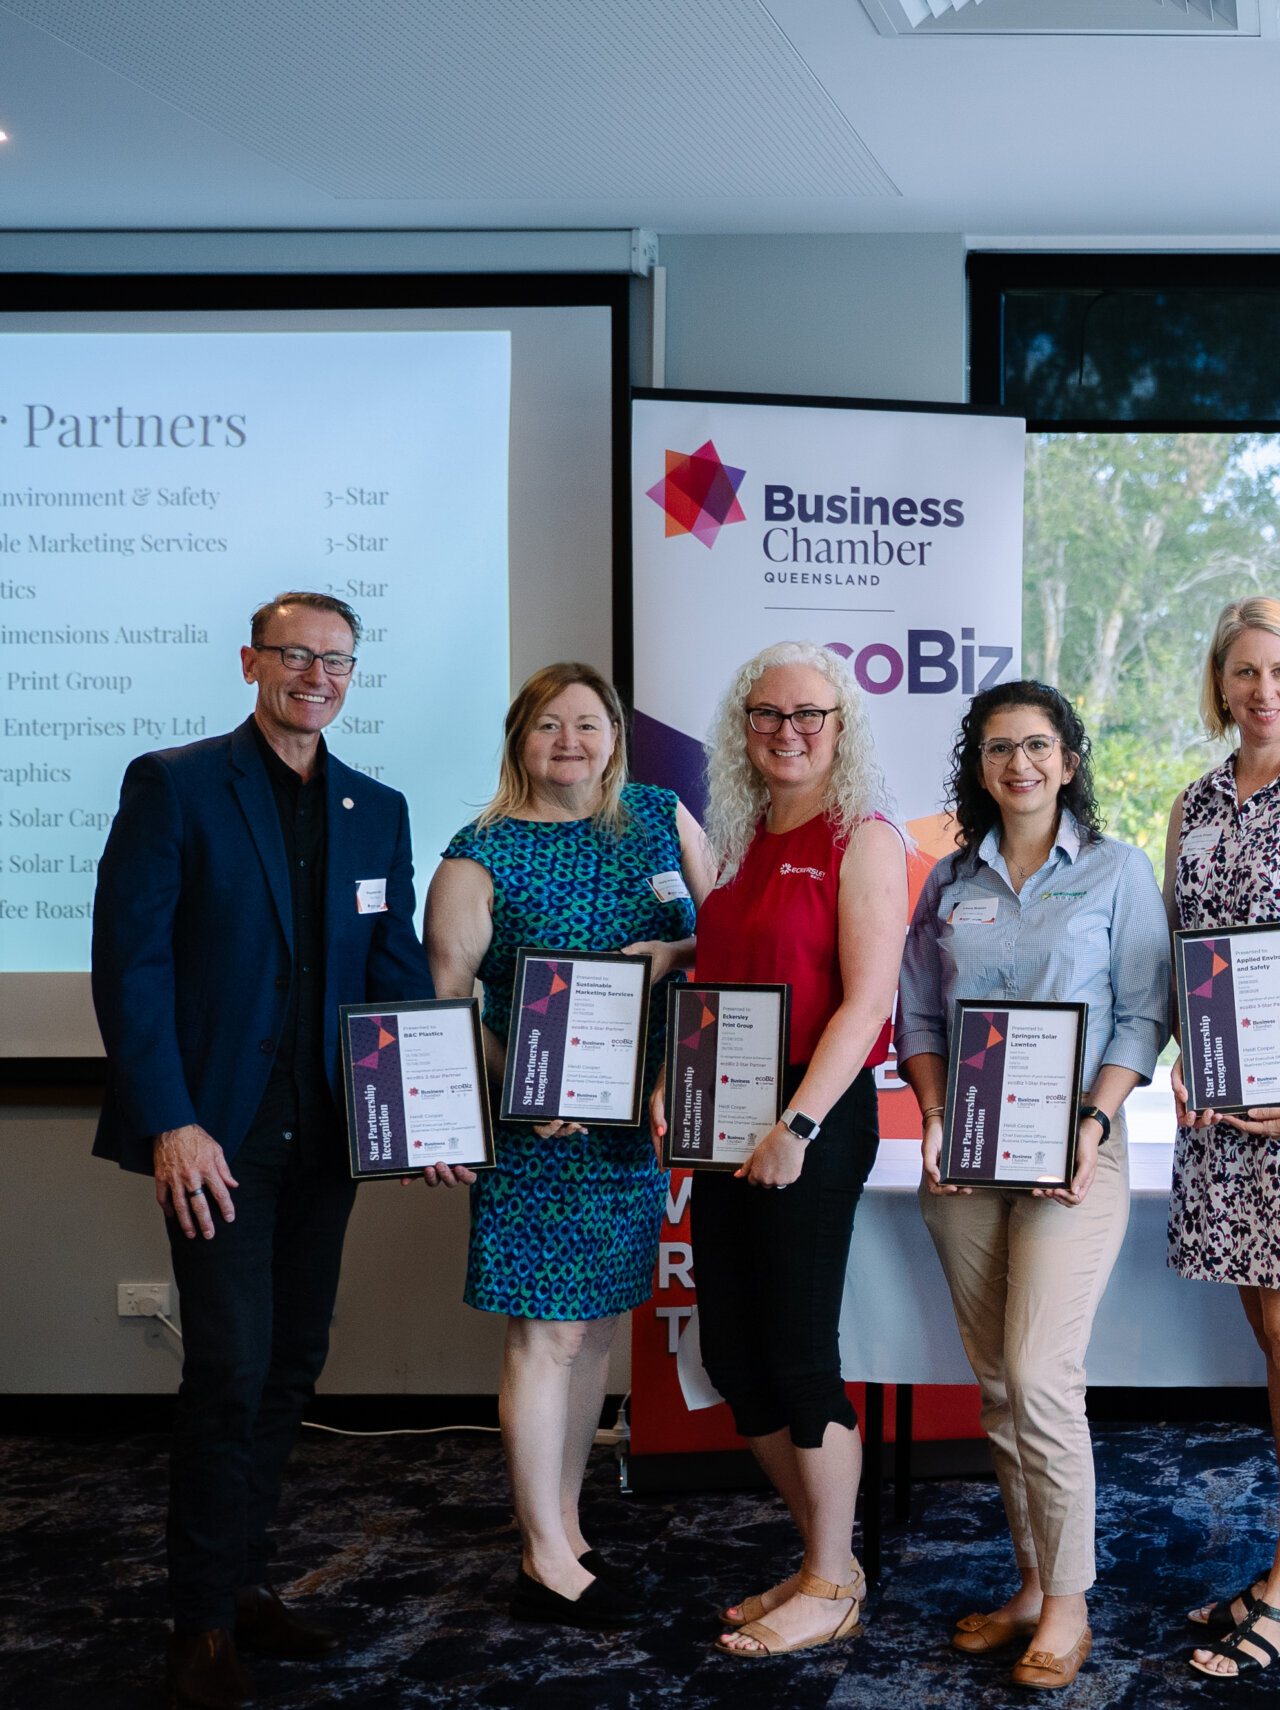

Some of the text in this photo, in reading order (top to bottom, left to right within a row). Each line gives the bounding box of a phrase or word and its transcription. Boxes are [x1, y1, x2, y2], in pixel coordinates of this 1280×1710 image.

[23, 404, 247, 448] Partners
[0, 486, 220, 510] nvironment & Safety
[324, 486, 389, 509] 3-Star
[764, 484, 965, 528] Business
[28, 532, 135, 557] Marketing
[141, 532, 227, 553] Services
[324, 532, 389, 555] 3-Star
[762, 527, 932, 566] Chamber
[764, 571, 880, 586] QUEENSLAND
[115, 623, 208, 645] Australia
[7, 671, 132, 694] Print Group
[823, 627, 1013, 695] oBiz
[4, 716, 206, 741] Enterprises Pty Ltd
[9, 807, 63, 828] Solar
[9, 853, 64, 874] Solar
[523, 1029, 541, 1105] Star Partnership
[535, 1051, 549, 1106] Recognition
[1200, 1016, 1214, 1098] Star Partnership
[1214, 1037, 1226, 1096] Recognition
[683, 1067, 695, 1126] Partnership
[364, 1085, 379, 1160] Star Partnership
[379, 1105, 392, 1160] Recognition
[692, 1090, 702, 1148] Recognition
[961, 1086, 978, 1168] Star Partnership
[972, 1109, 985, 1168] Recognition
